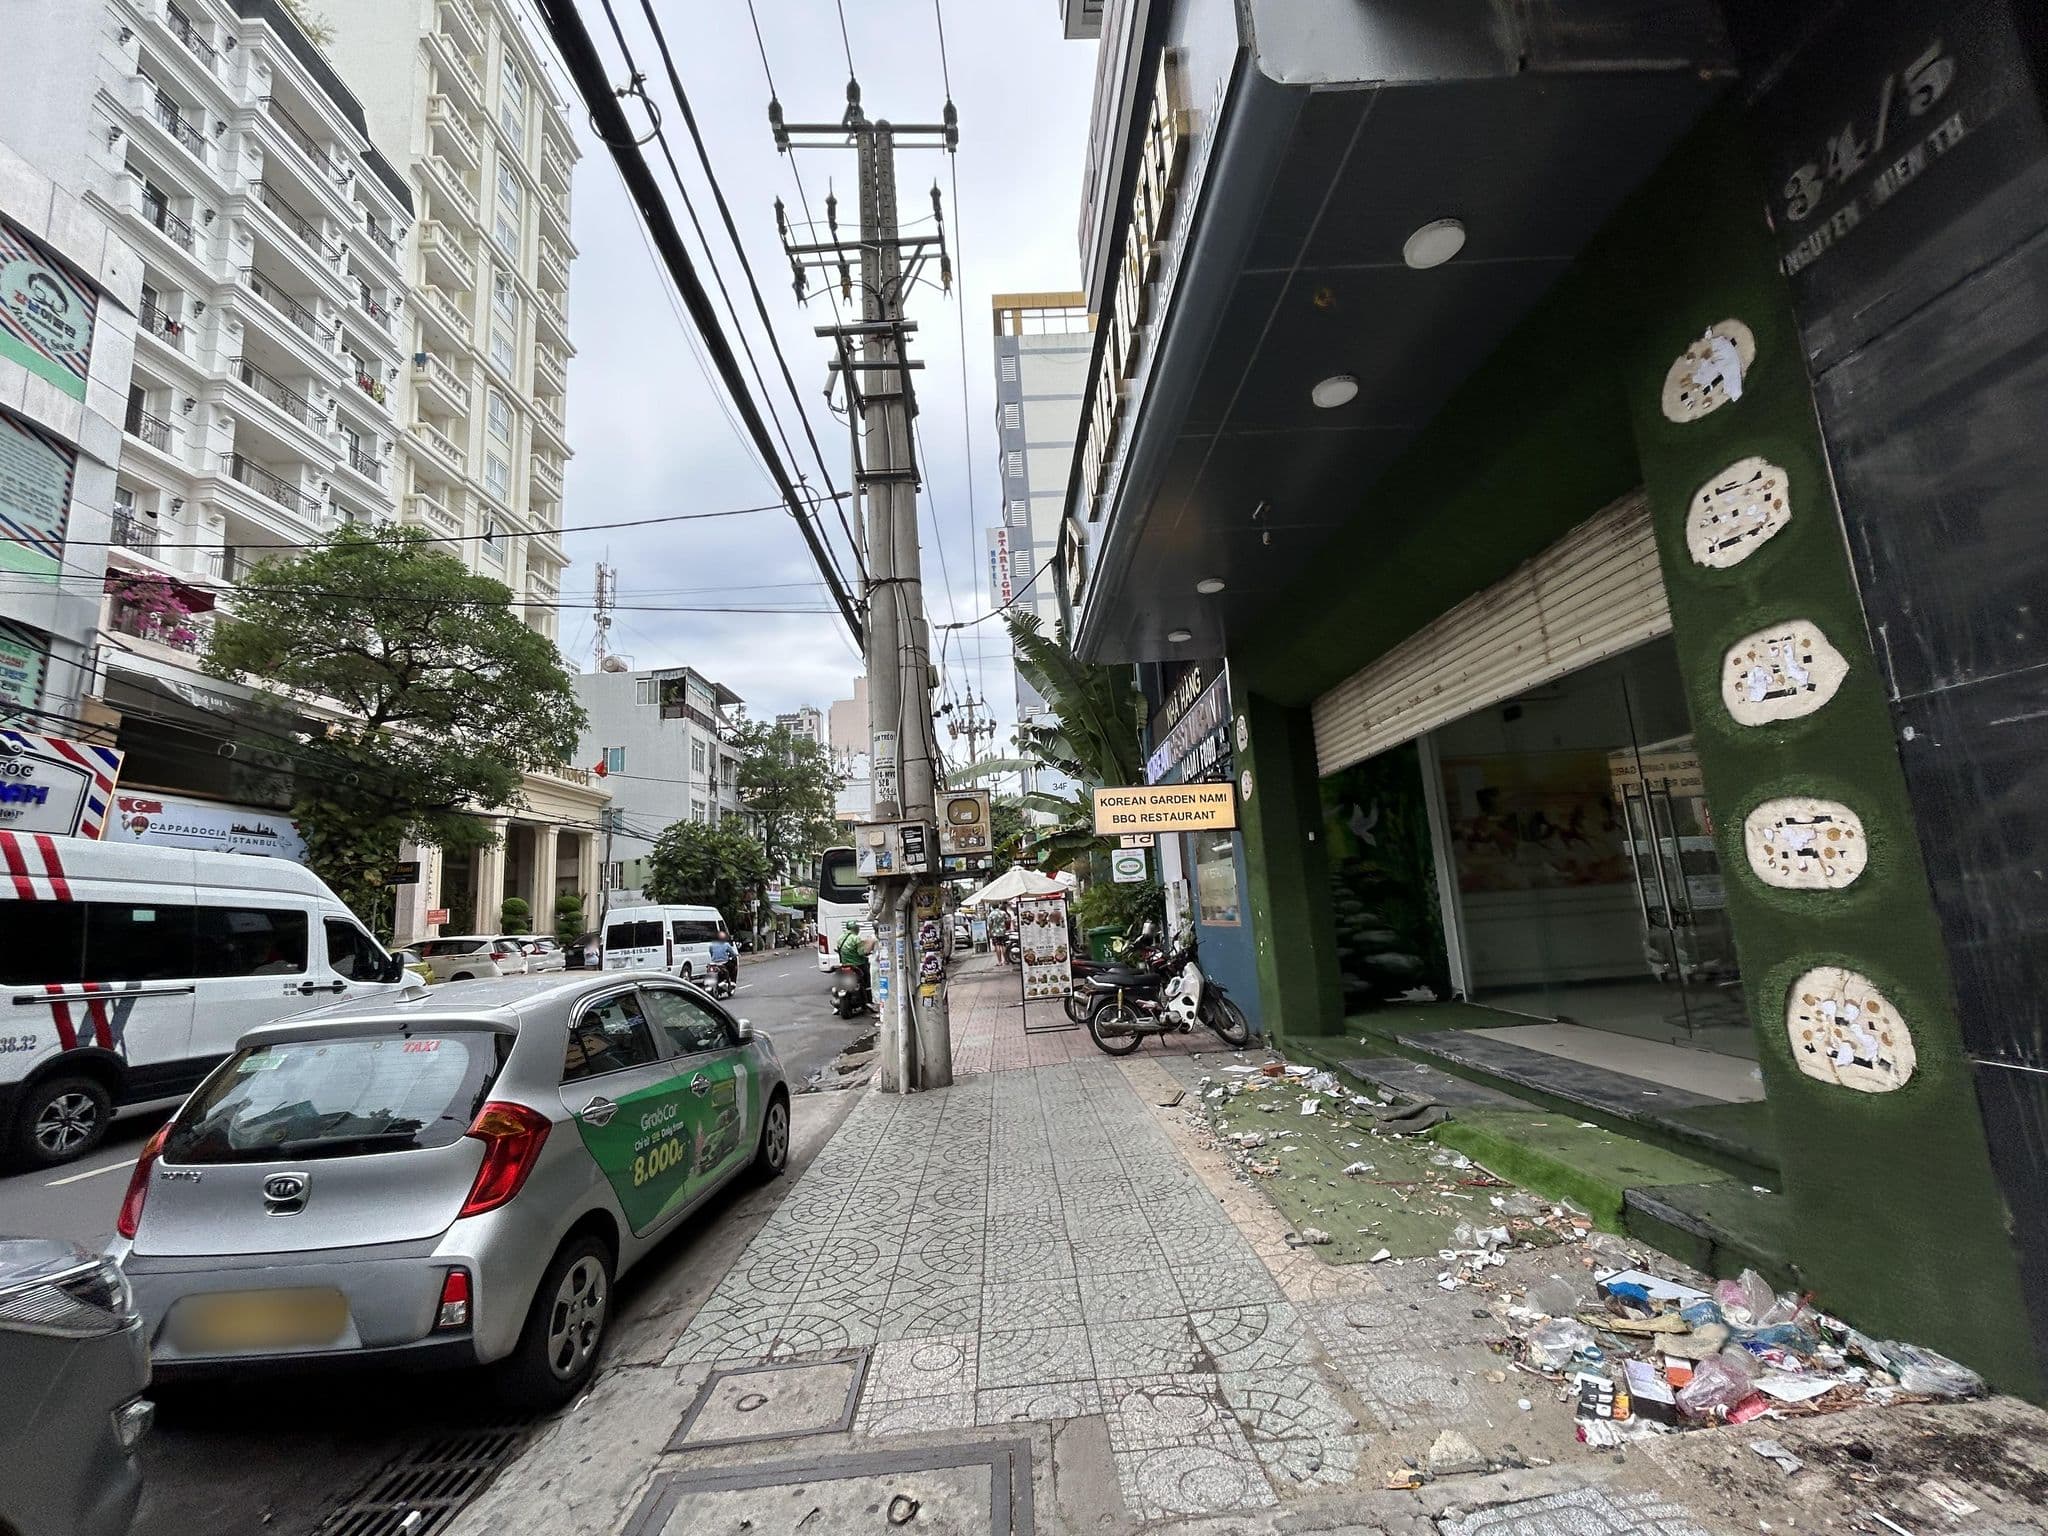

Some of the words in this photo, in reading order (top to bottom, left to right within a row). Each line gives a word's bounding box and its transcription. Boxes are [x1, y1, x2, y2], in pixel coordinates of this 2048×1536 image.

[1115, 47, 1178, 380] HOTEL
[998, 530, 1011, 606] STARLIGHT
[1100, 796, 1147, 807] KOREAN
[1150, 795, 1196, 805] GARDEN
[1200, 793, 1228, 803] NAMI
[1112, 814, 1137, 824] BBQ
[1140, 810, 1216, 822] RESTAURANT
[150, 823, 227, 837] CAPPADOCIA
[402, 1040, 442, 1053] TAXI
[640, 1104, 678, 1131] GrabCar
[269, 1182, 297, 1195] KIA
